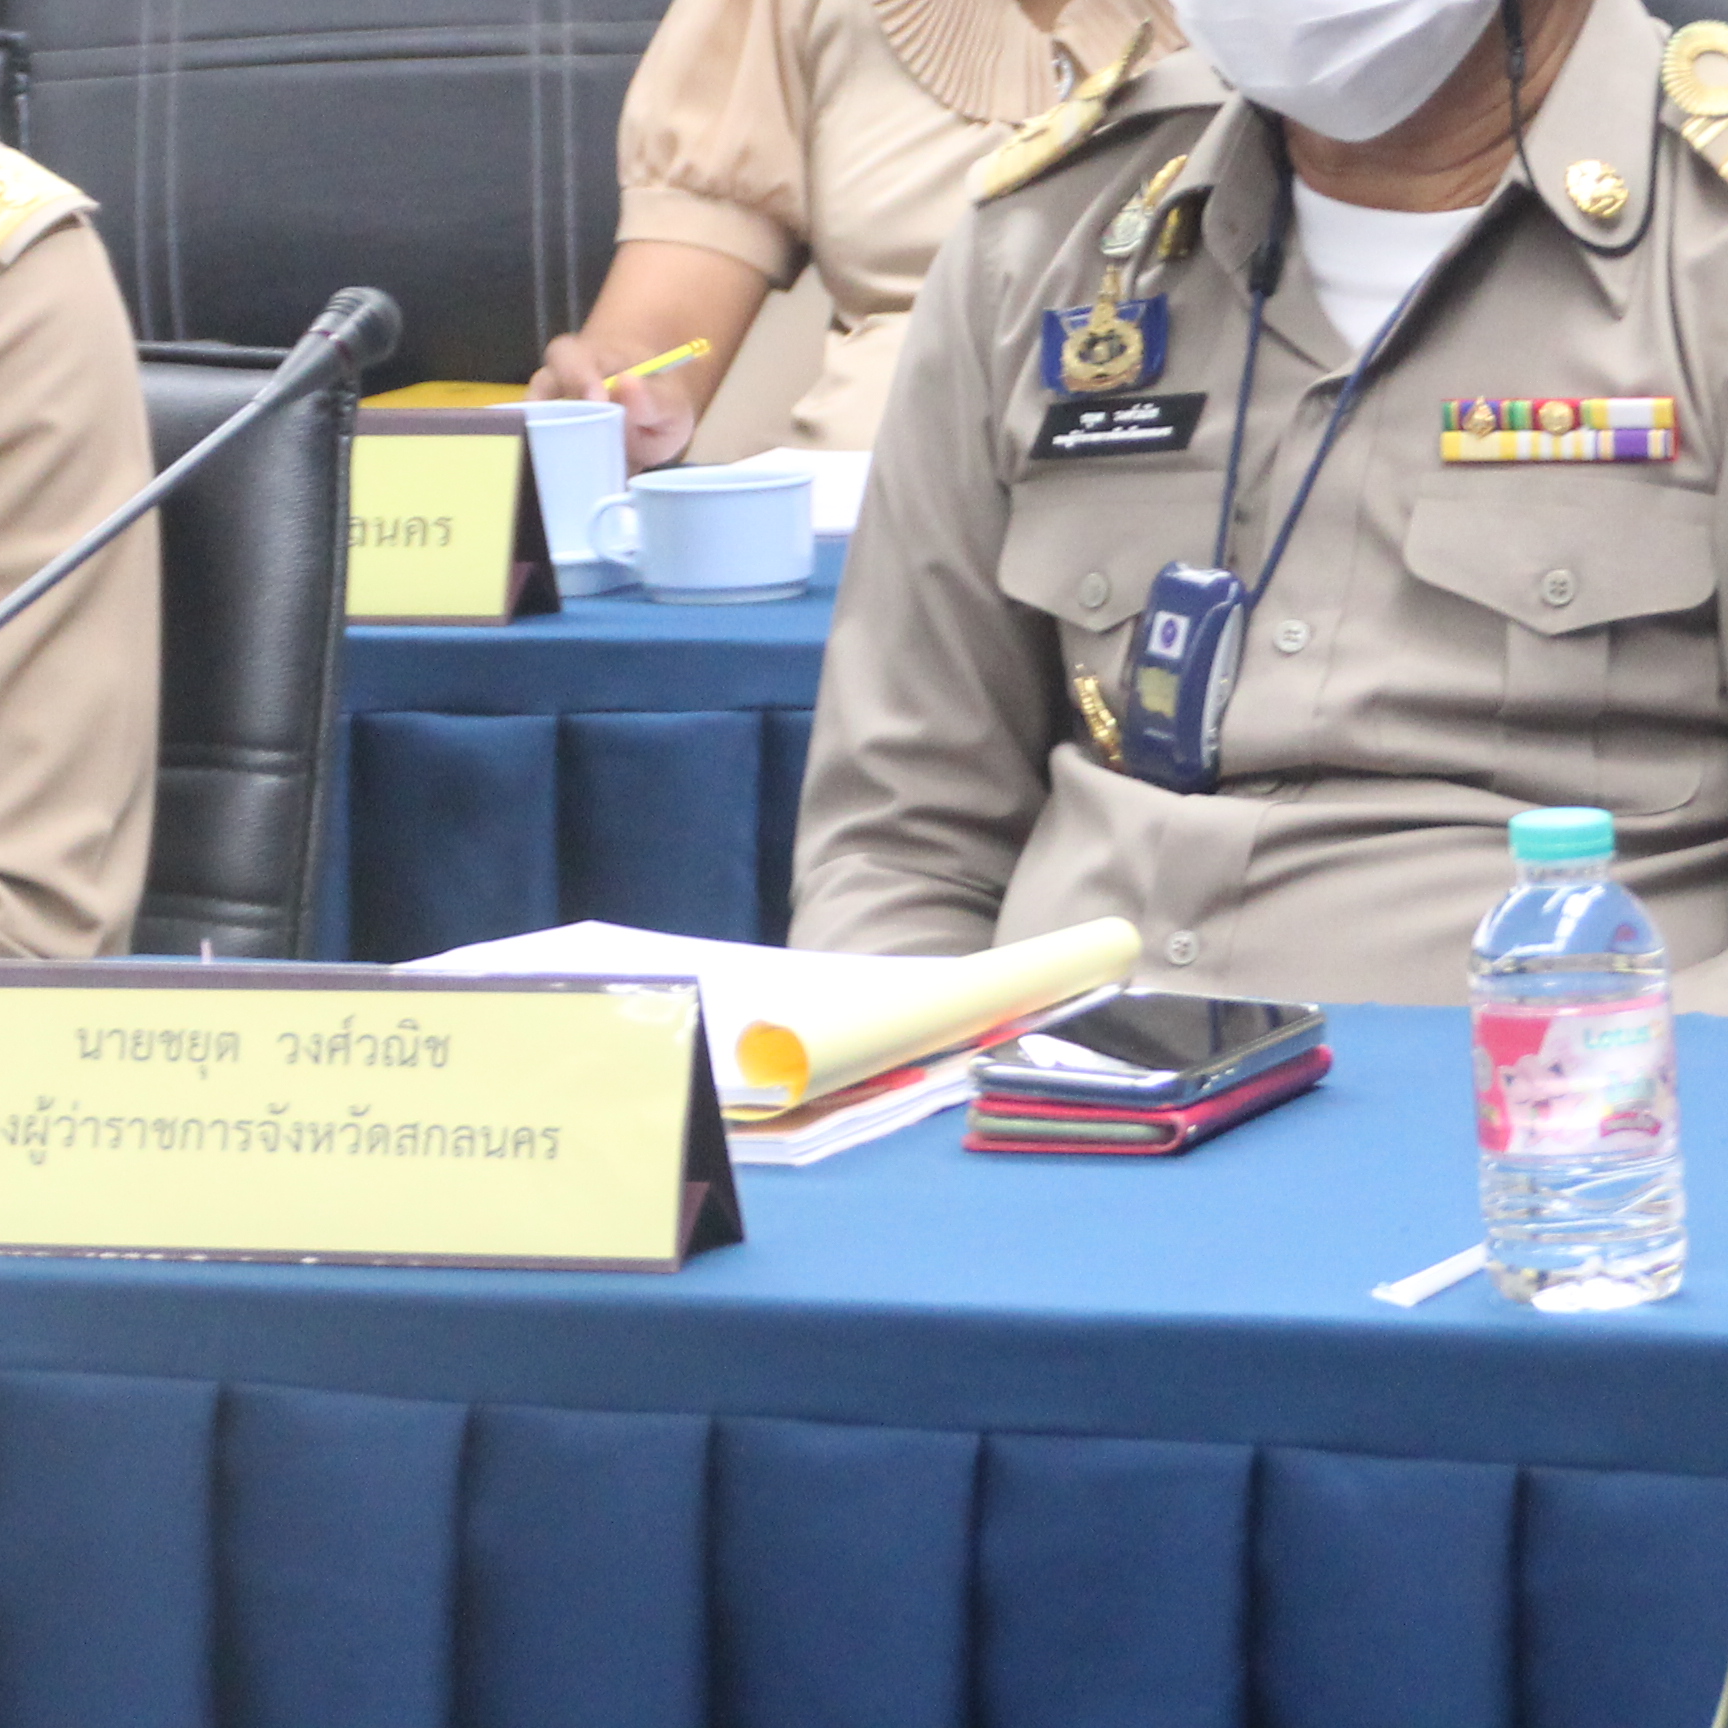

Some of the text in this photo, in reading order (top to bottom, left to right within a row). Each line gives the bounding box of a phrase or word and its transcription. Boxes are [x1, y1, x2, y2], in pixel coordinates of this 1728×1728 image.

[347, 516, 453, 548] ลนคร
[276, 1013, 452, 1071] วงศ์วณิช
